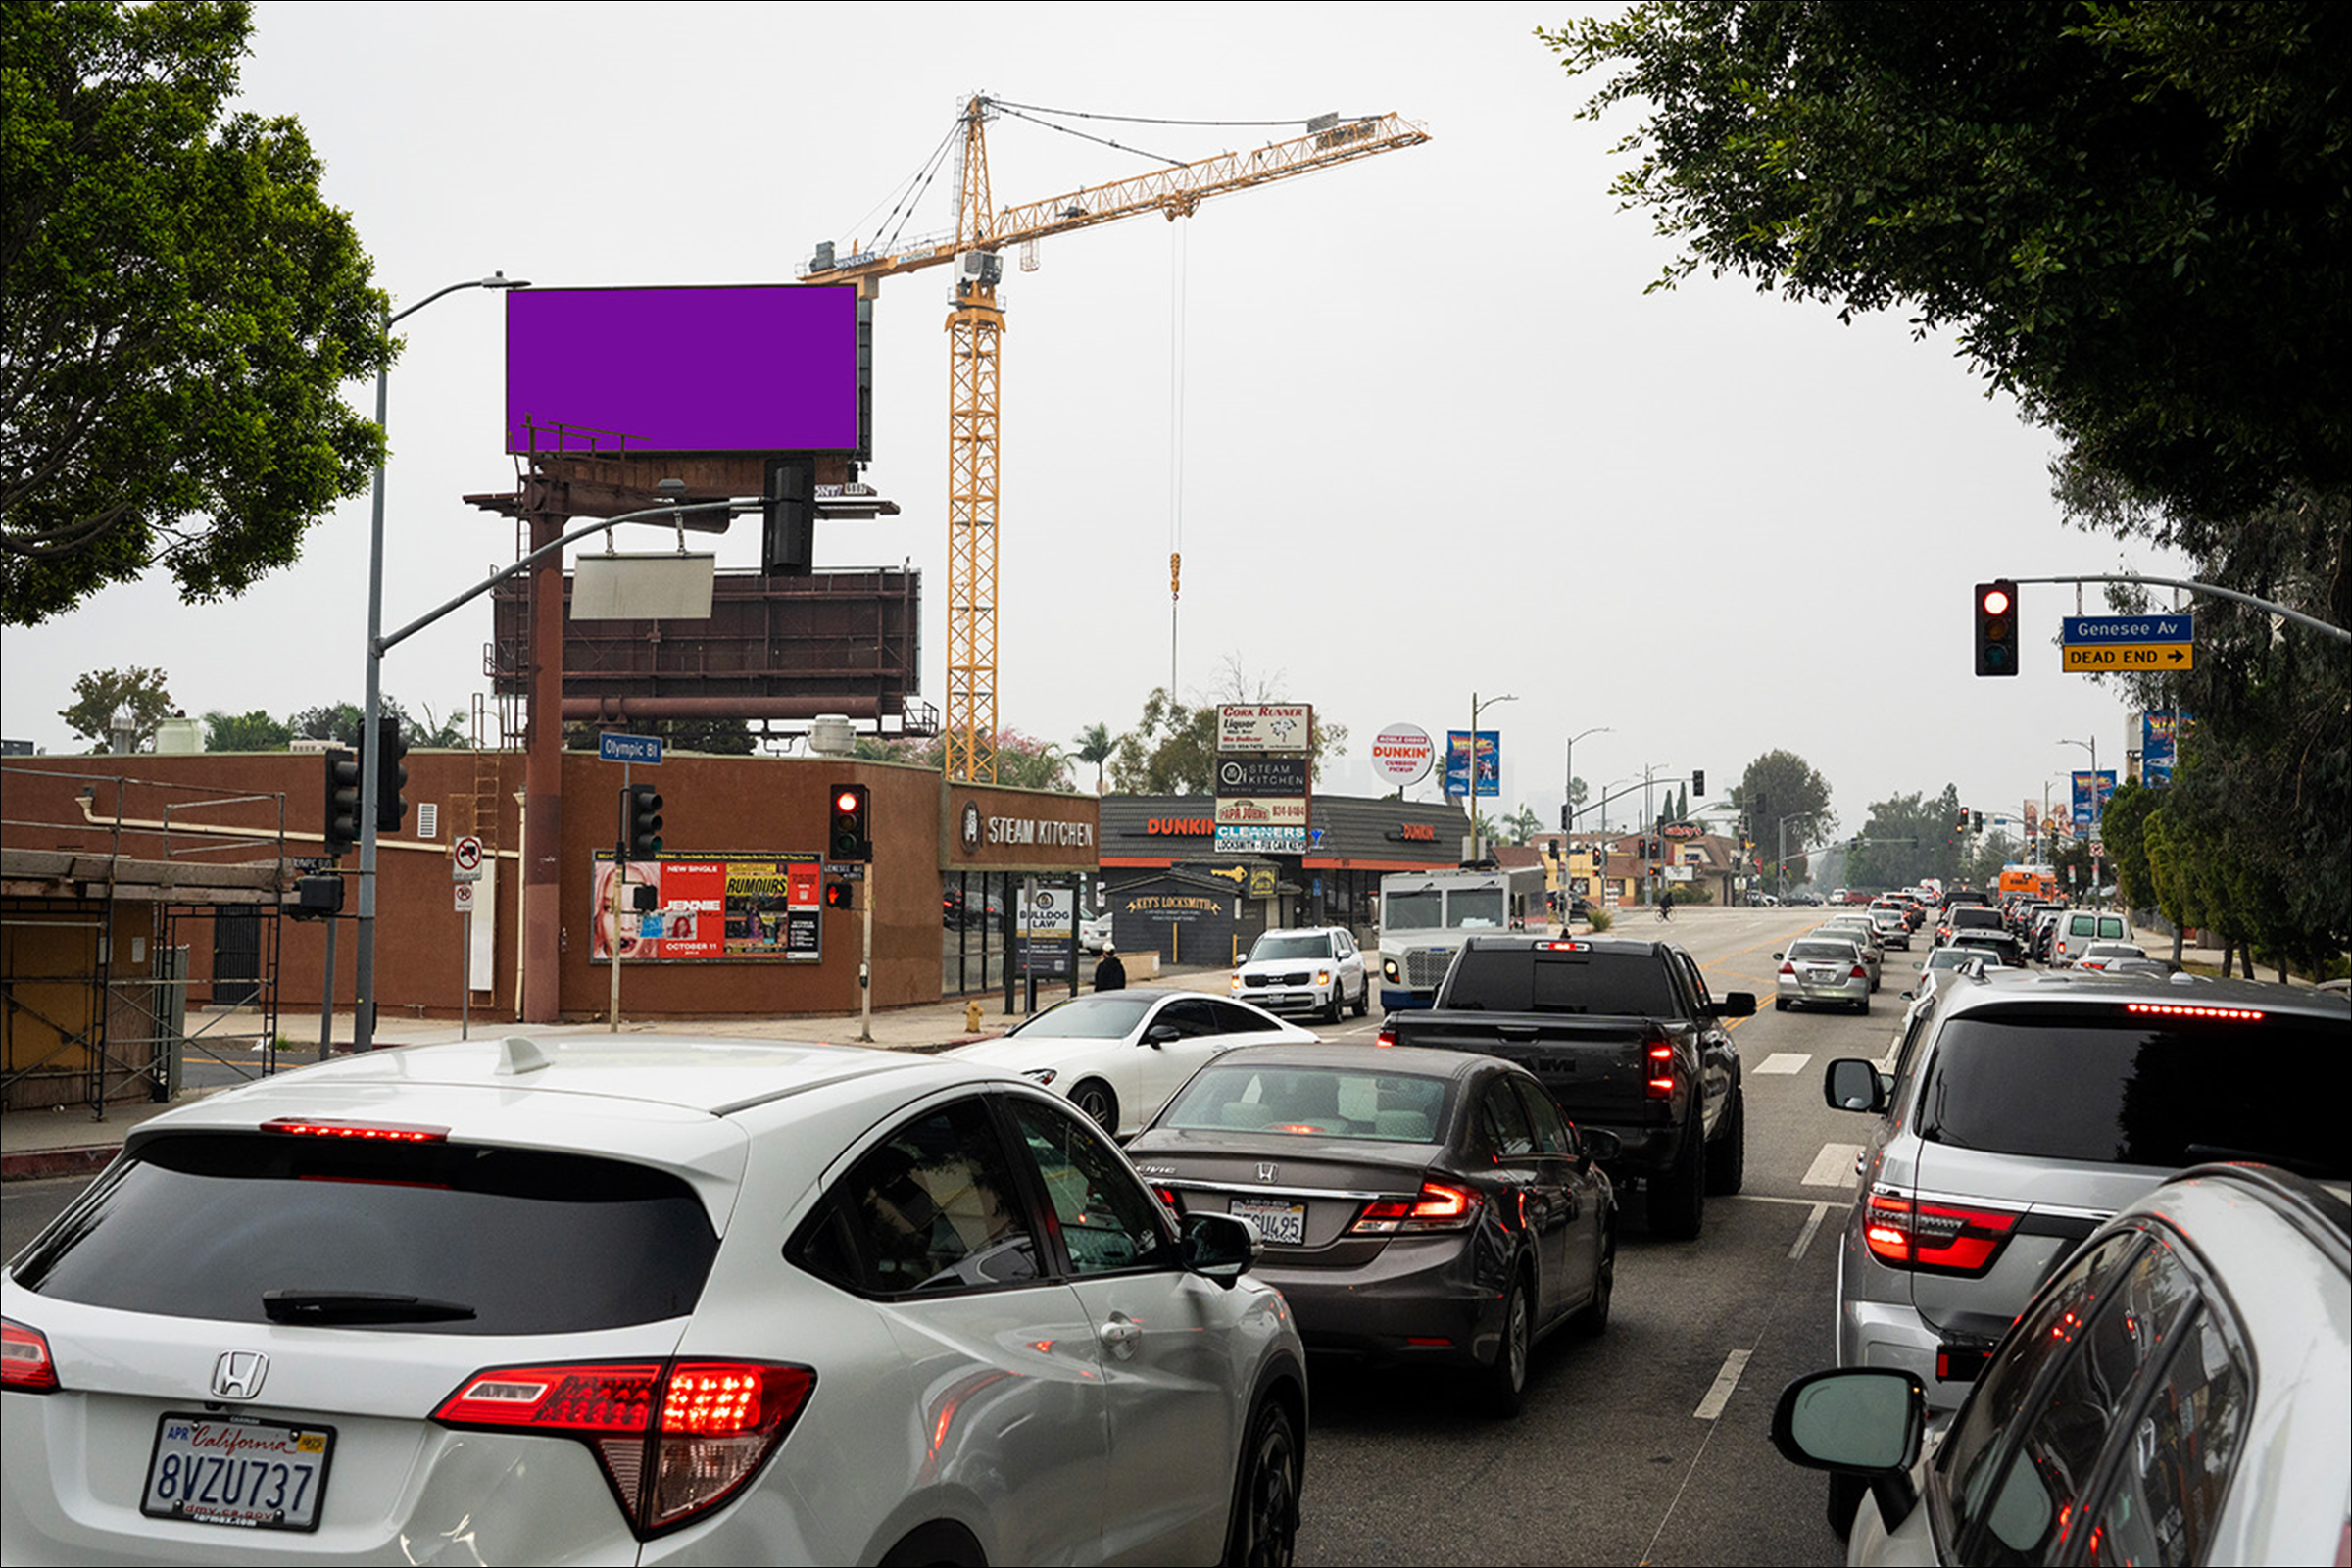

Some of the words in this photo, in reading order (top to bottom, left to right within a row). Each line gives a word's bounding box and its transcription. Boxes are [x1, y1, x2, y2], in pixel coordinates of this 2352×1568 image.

[2078, 622, 2150, 637] Genesee
[2158, 621, 2178, 635] Av
[2071, 651, 2115, 664] DEAD
[2124, 650, 2158, 663] END
[1223, 706, 1254, 717] CORK
[1258, 706, 1303, 716] RUNNER
[1224, 718, 1256, 730] Liquor
[605, 739, 644, 758] Olympic
[647, 743, 658, 757] Bl
[1373, 746, 1431, 759] DUNKIN'
[1249, 764, 1291, 774] STEAM
[1249, 775, 1303, 785] KITCHEN
[988, 816, 1035, 844] STEAM
[1037, 820, 1094, 846] KITCHEN
[1217, 826, 1305, 838] CLEANERS
[1217, 840, 1255, 850] LOCKSMITH
[726, 878, 787, 893] RUMOURS
[663, 900, 721, 911] JENNIE
[1161, 896, 1212, 911] LOCKSMITH
[666, 942, 707, 951] OCTOBER
[1136, 1165, 1177, 1175] CIVIC
[1233, 1212, 1299, 1238] SU495
[167, 1427, 189, 1441] APR
[192, 1425, 297, 1457] California
[158, 1453, 314, 1511] 8VZU737
[185, 1504, 273, 1520] dmv.ca.gov
[193, 1514, 258, 1527] carmax.com
